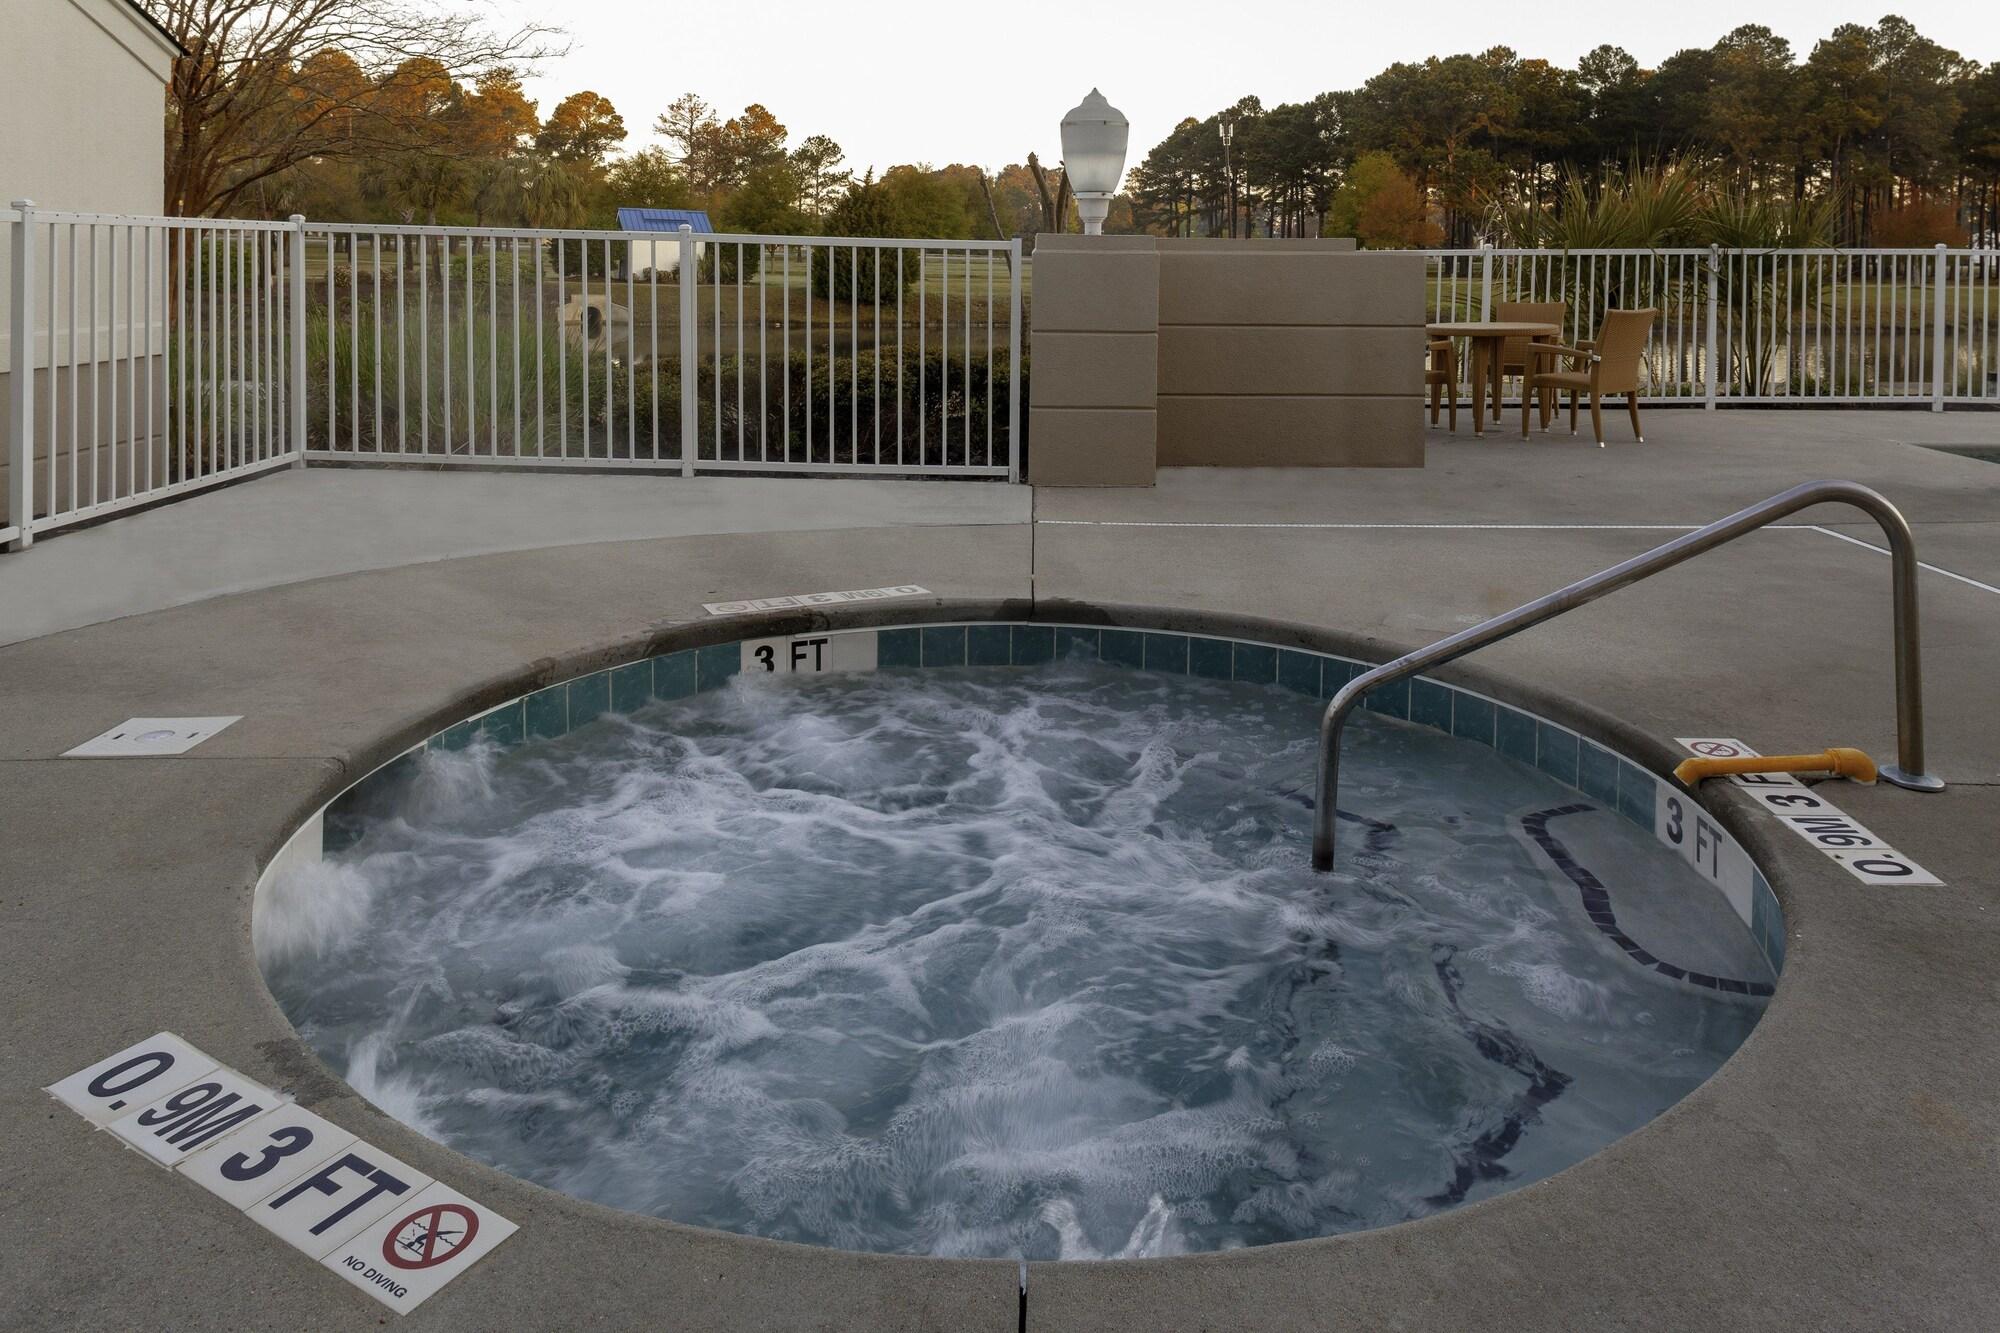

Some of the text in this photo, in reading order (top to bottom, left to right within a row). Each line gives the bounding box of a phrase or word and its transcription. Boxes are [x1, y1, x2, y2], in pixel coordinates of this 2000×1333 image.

[755, 638, 828, 673] 3 FT
[1765, 794, 1821, 808] 3
[1666, 797, 1722, 879] 3 FT
[220, 1126, 314, 1181] 3
[268, 1153, 411, 1236] FT
[342, 1255, 408, 1298] NO DIVING
